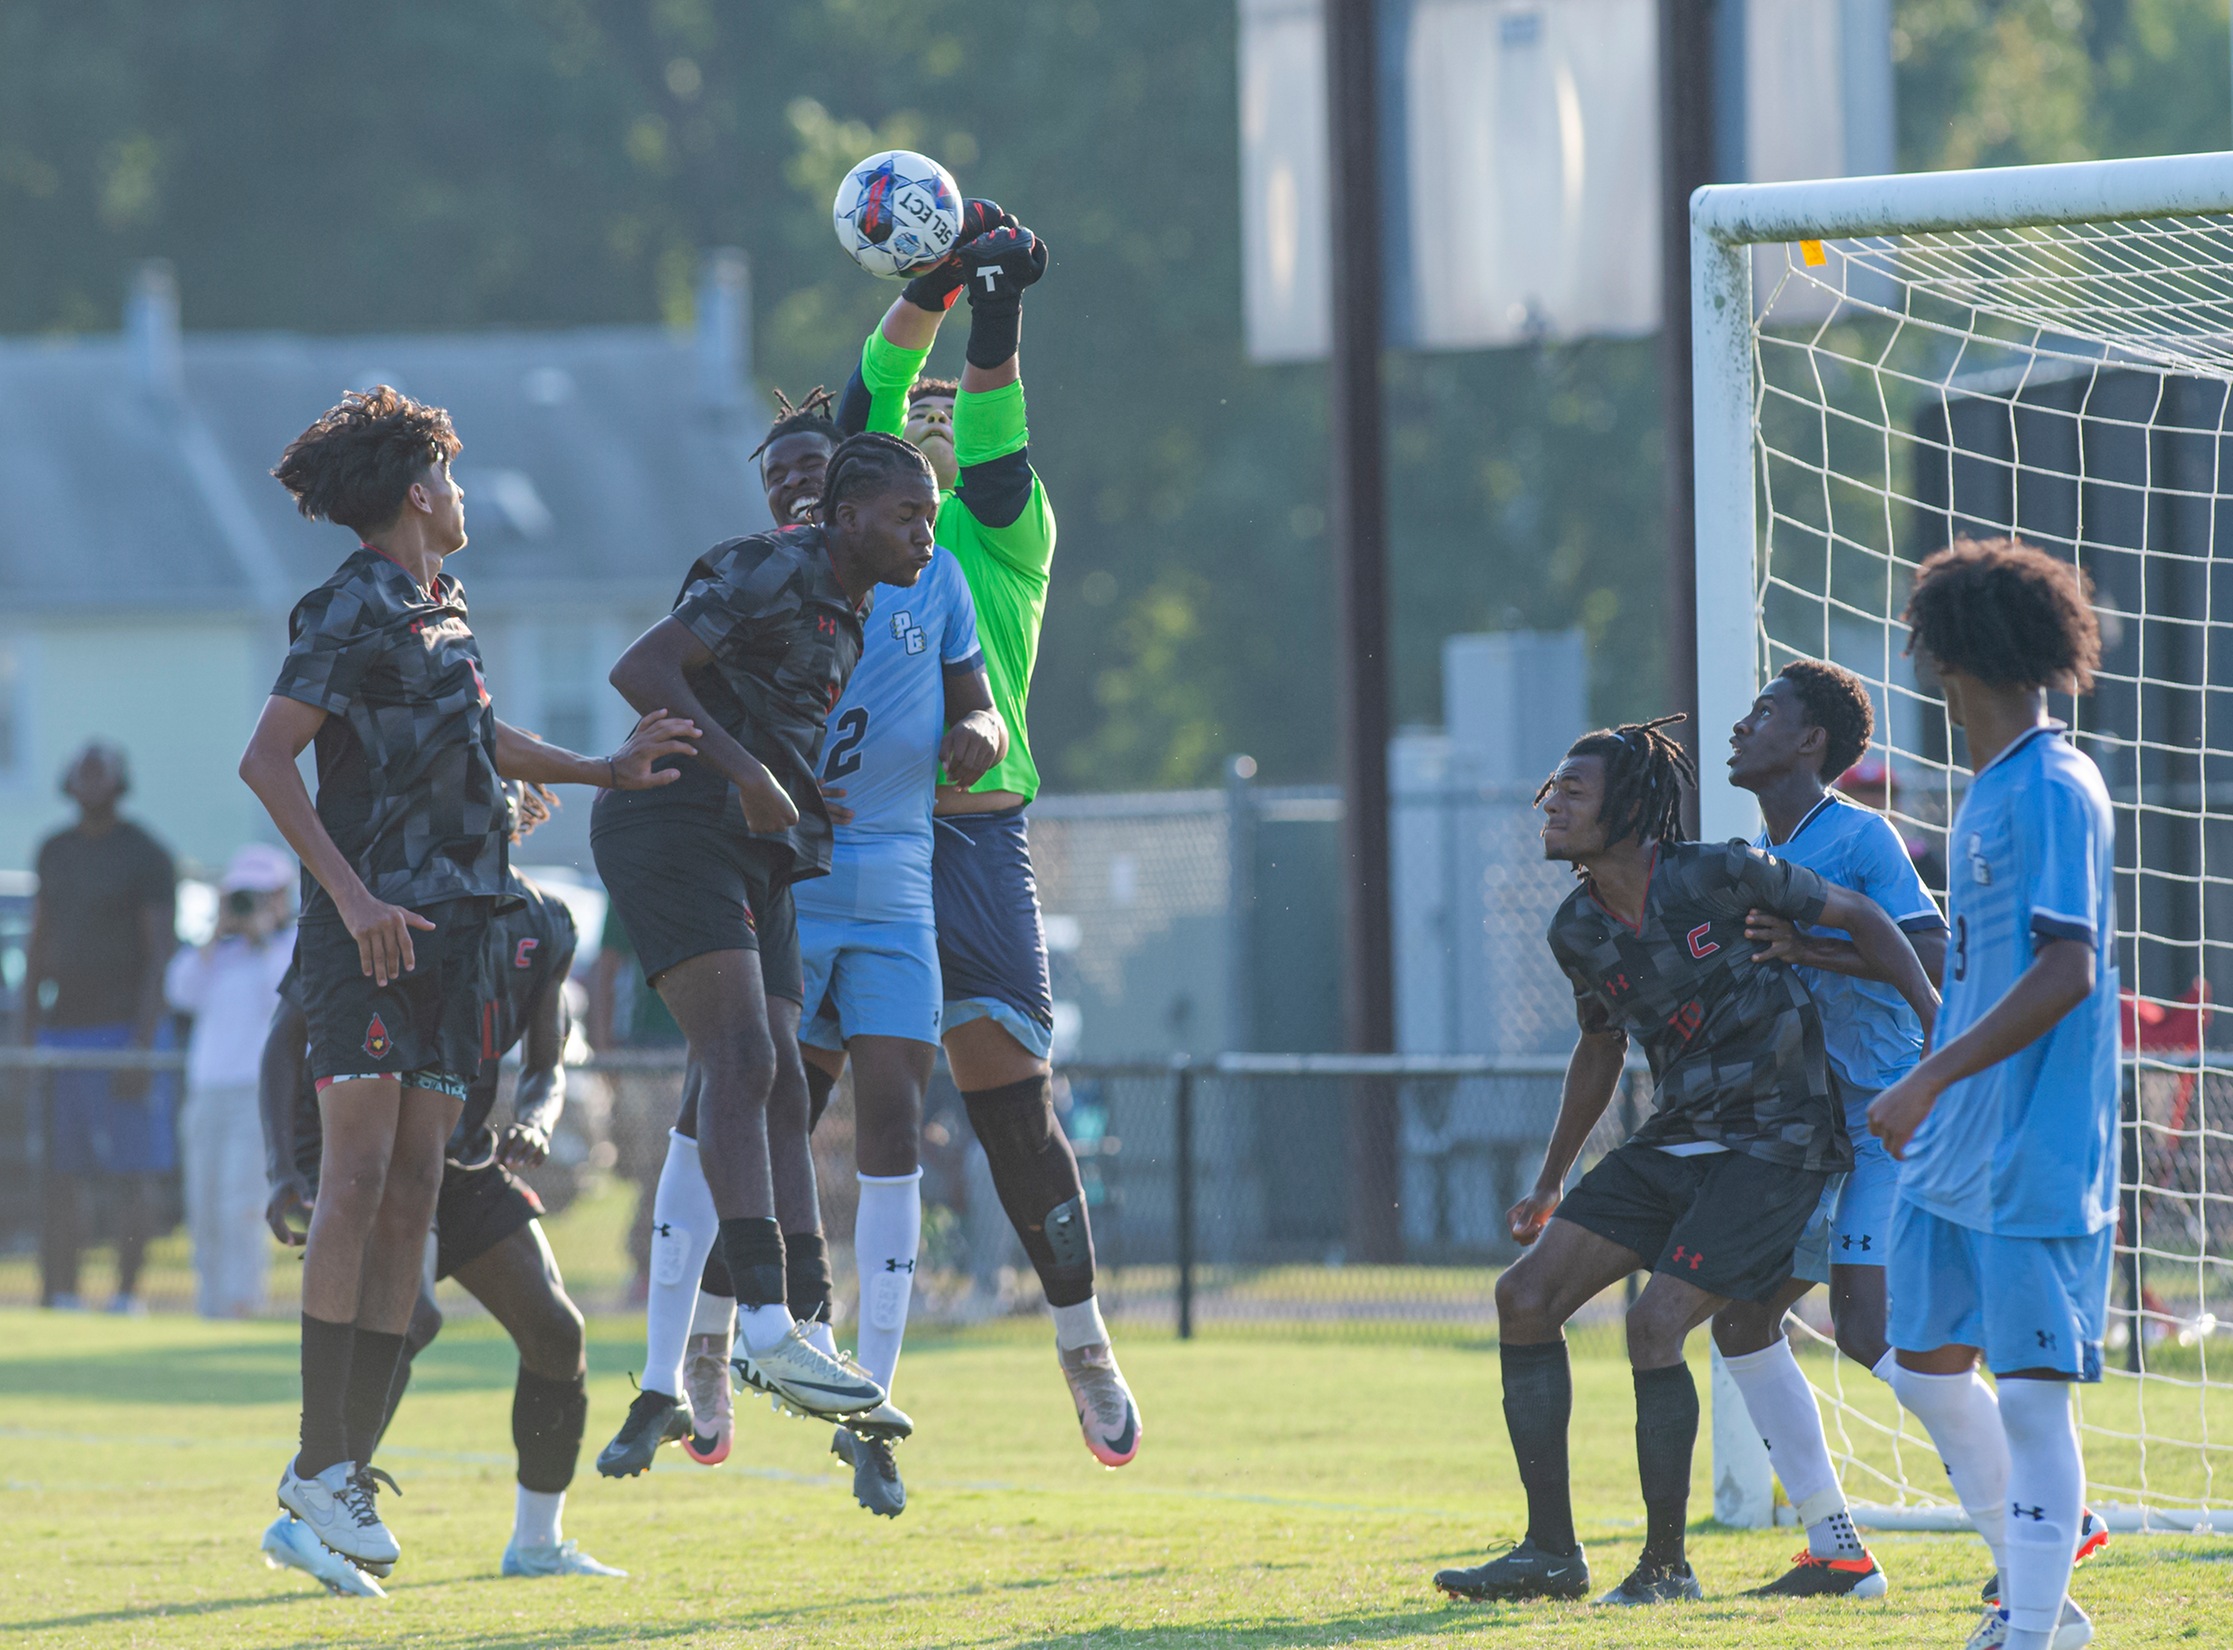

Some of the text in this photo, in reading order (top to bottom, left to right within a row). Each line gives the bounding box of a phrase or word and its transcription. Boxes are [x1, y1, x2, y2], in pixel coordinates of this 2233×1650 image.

[898, 192, 953, 246] SELECT
[822, 706, 870, 785] 2
[514, 937, 539, 968] C
[1685, 920, 1721, 960] C
